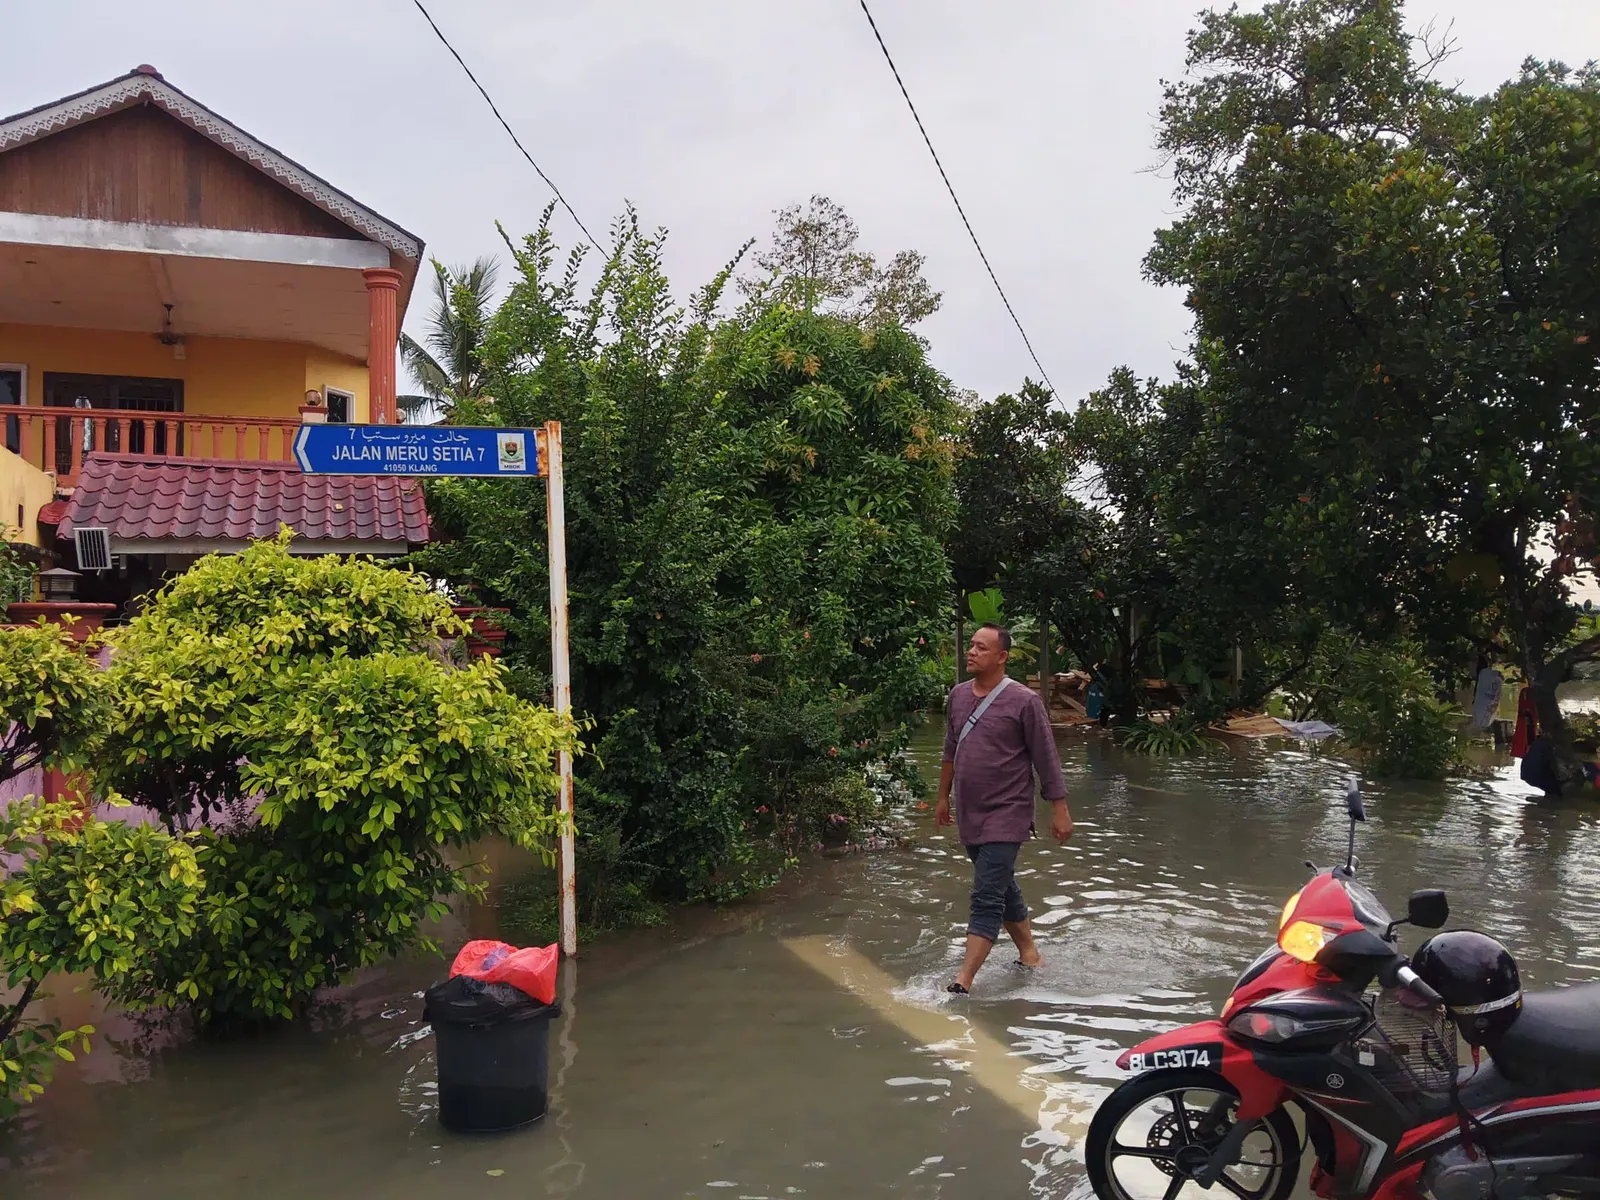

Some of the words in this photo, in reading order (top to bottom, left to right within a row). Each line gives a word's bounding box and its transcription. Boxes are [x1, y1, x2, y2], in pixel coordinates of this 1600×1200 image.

[348, 428, 356, 440] 7
[332, 445, 381, 460] JALAN
[386, 446, 428, 461] MERU
[432, 447, 475, 462] SETIA
[477, 447, 485, 462] 7
[384, 463, 406, 472] 41050
[409, 464, 437, 472] KLANG
[1129, 1049, 1210, 1071] BLC3174
